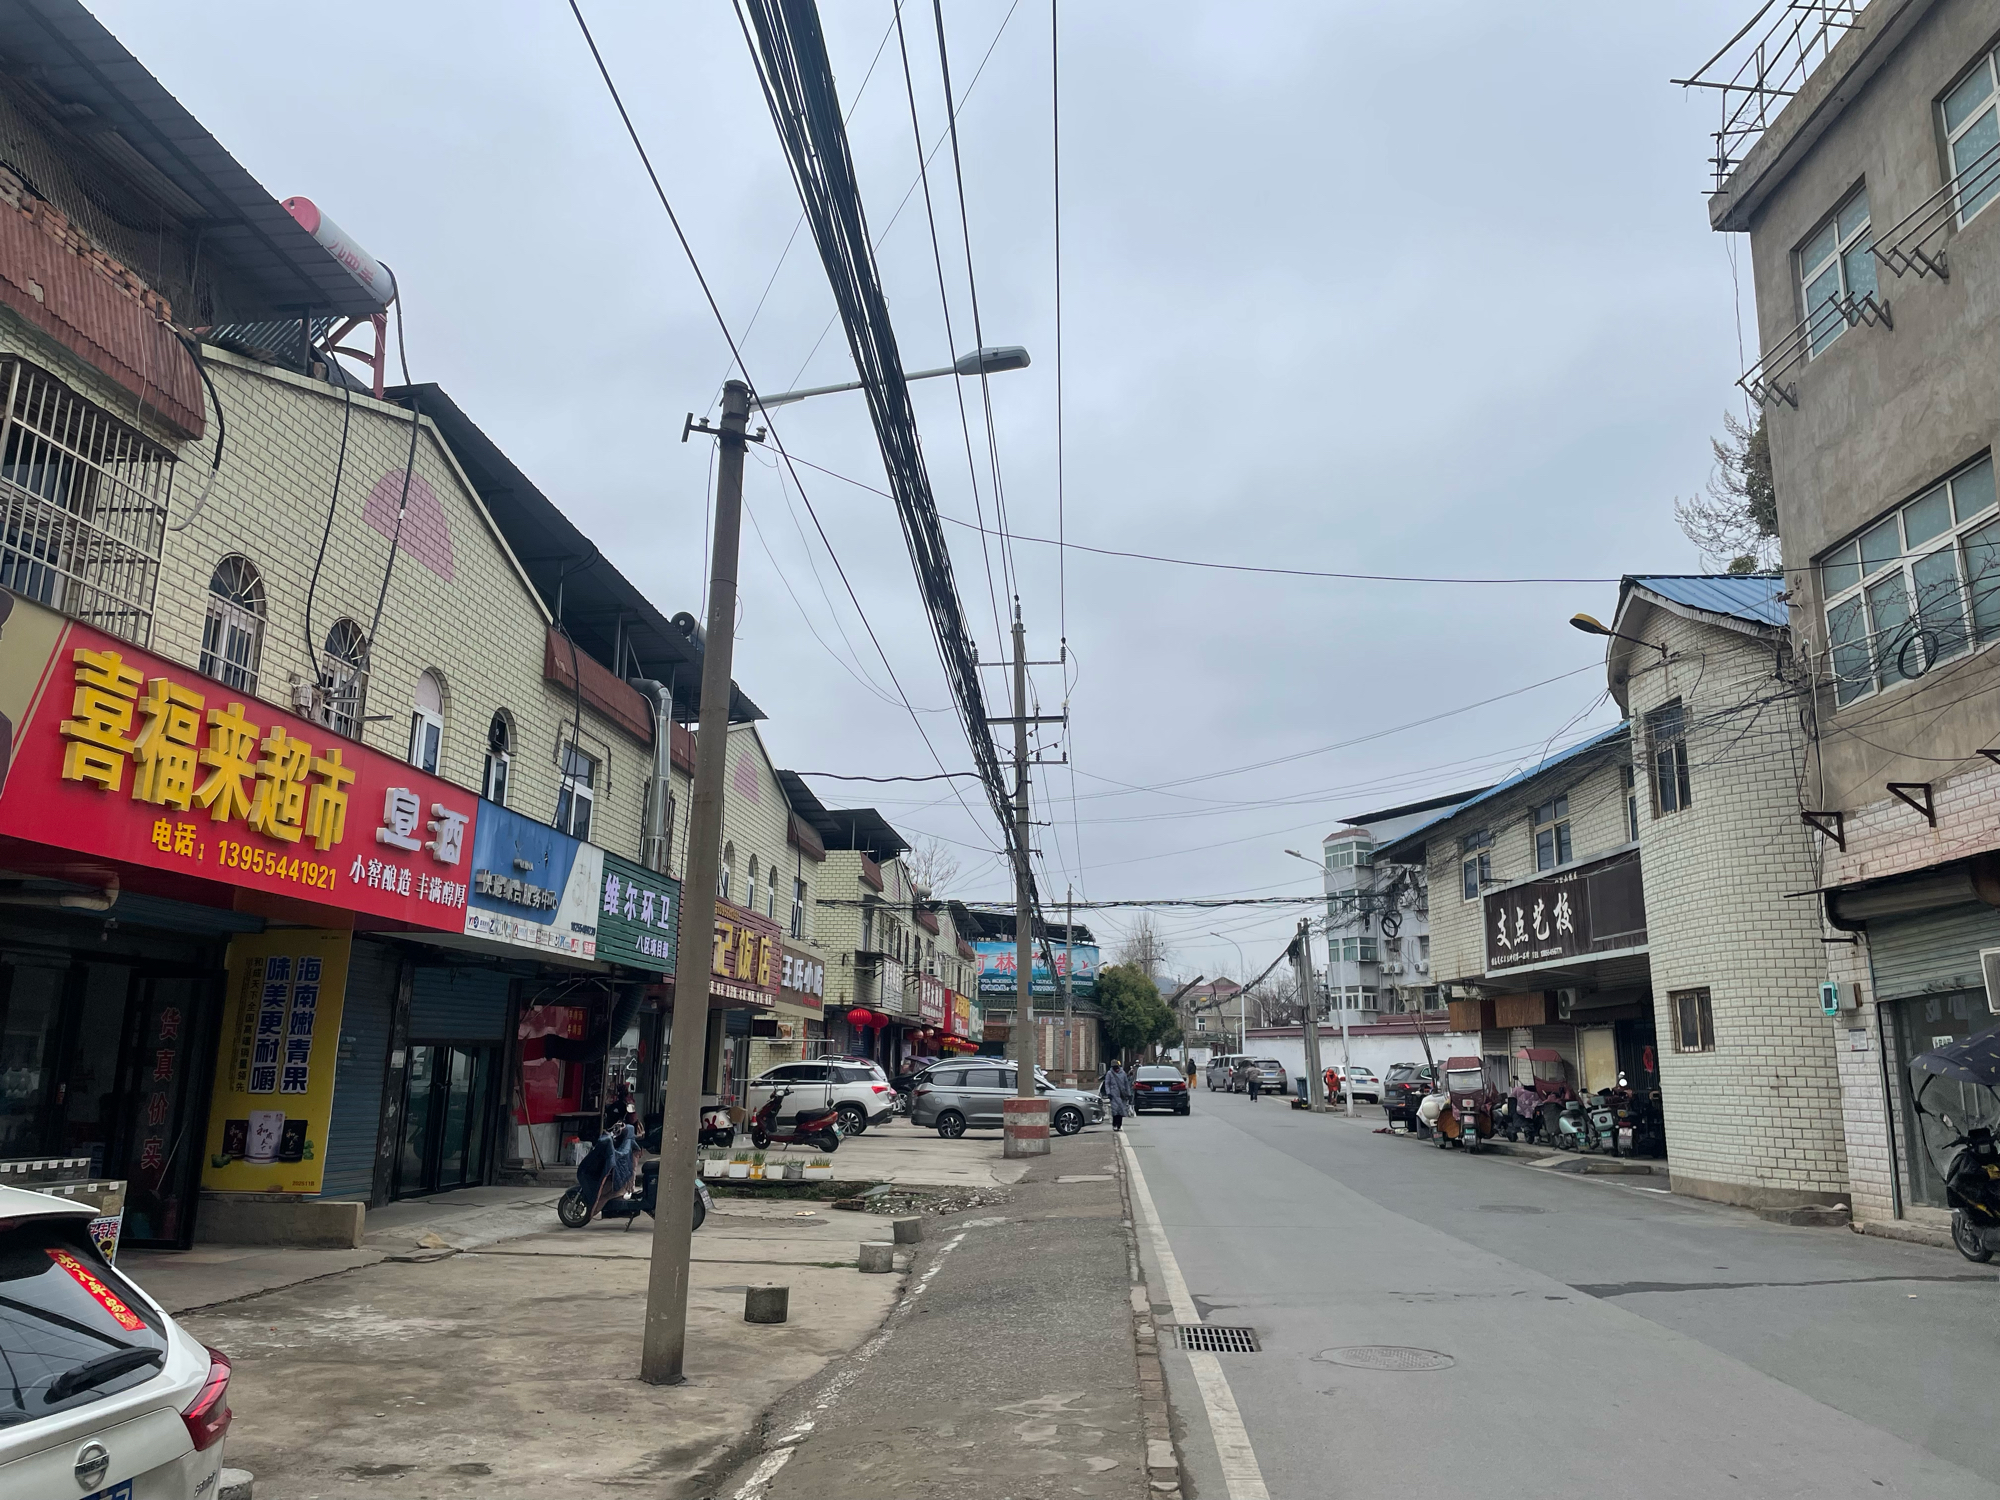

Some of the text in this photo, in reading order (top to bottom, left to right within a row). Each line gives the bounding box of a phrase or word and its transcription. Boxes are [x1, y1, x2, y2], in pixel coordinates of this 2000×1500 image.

[60, 648, 355, 851] 喜福来超市
[151, 818, 337, 890] 电话： 13955441921
[349, 854, 466, 909] 小窖酿造 丰满醇厚
[1497, 892, 1573, 949] 支点艺校
[248, 956, 292, 1094] 味美更耐嚼
[280, 956, 323, 1094] 海南嫩青果
[141, 1007, 181, 1169] 货真价实
[79, 1455, 109, 1475] NISSAN
